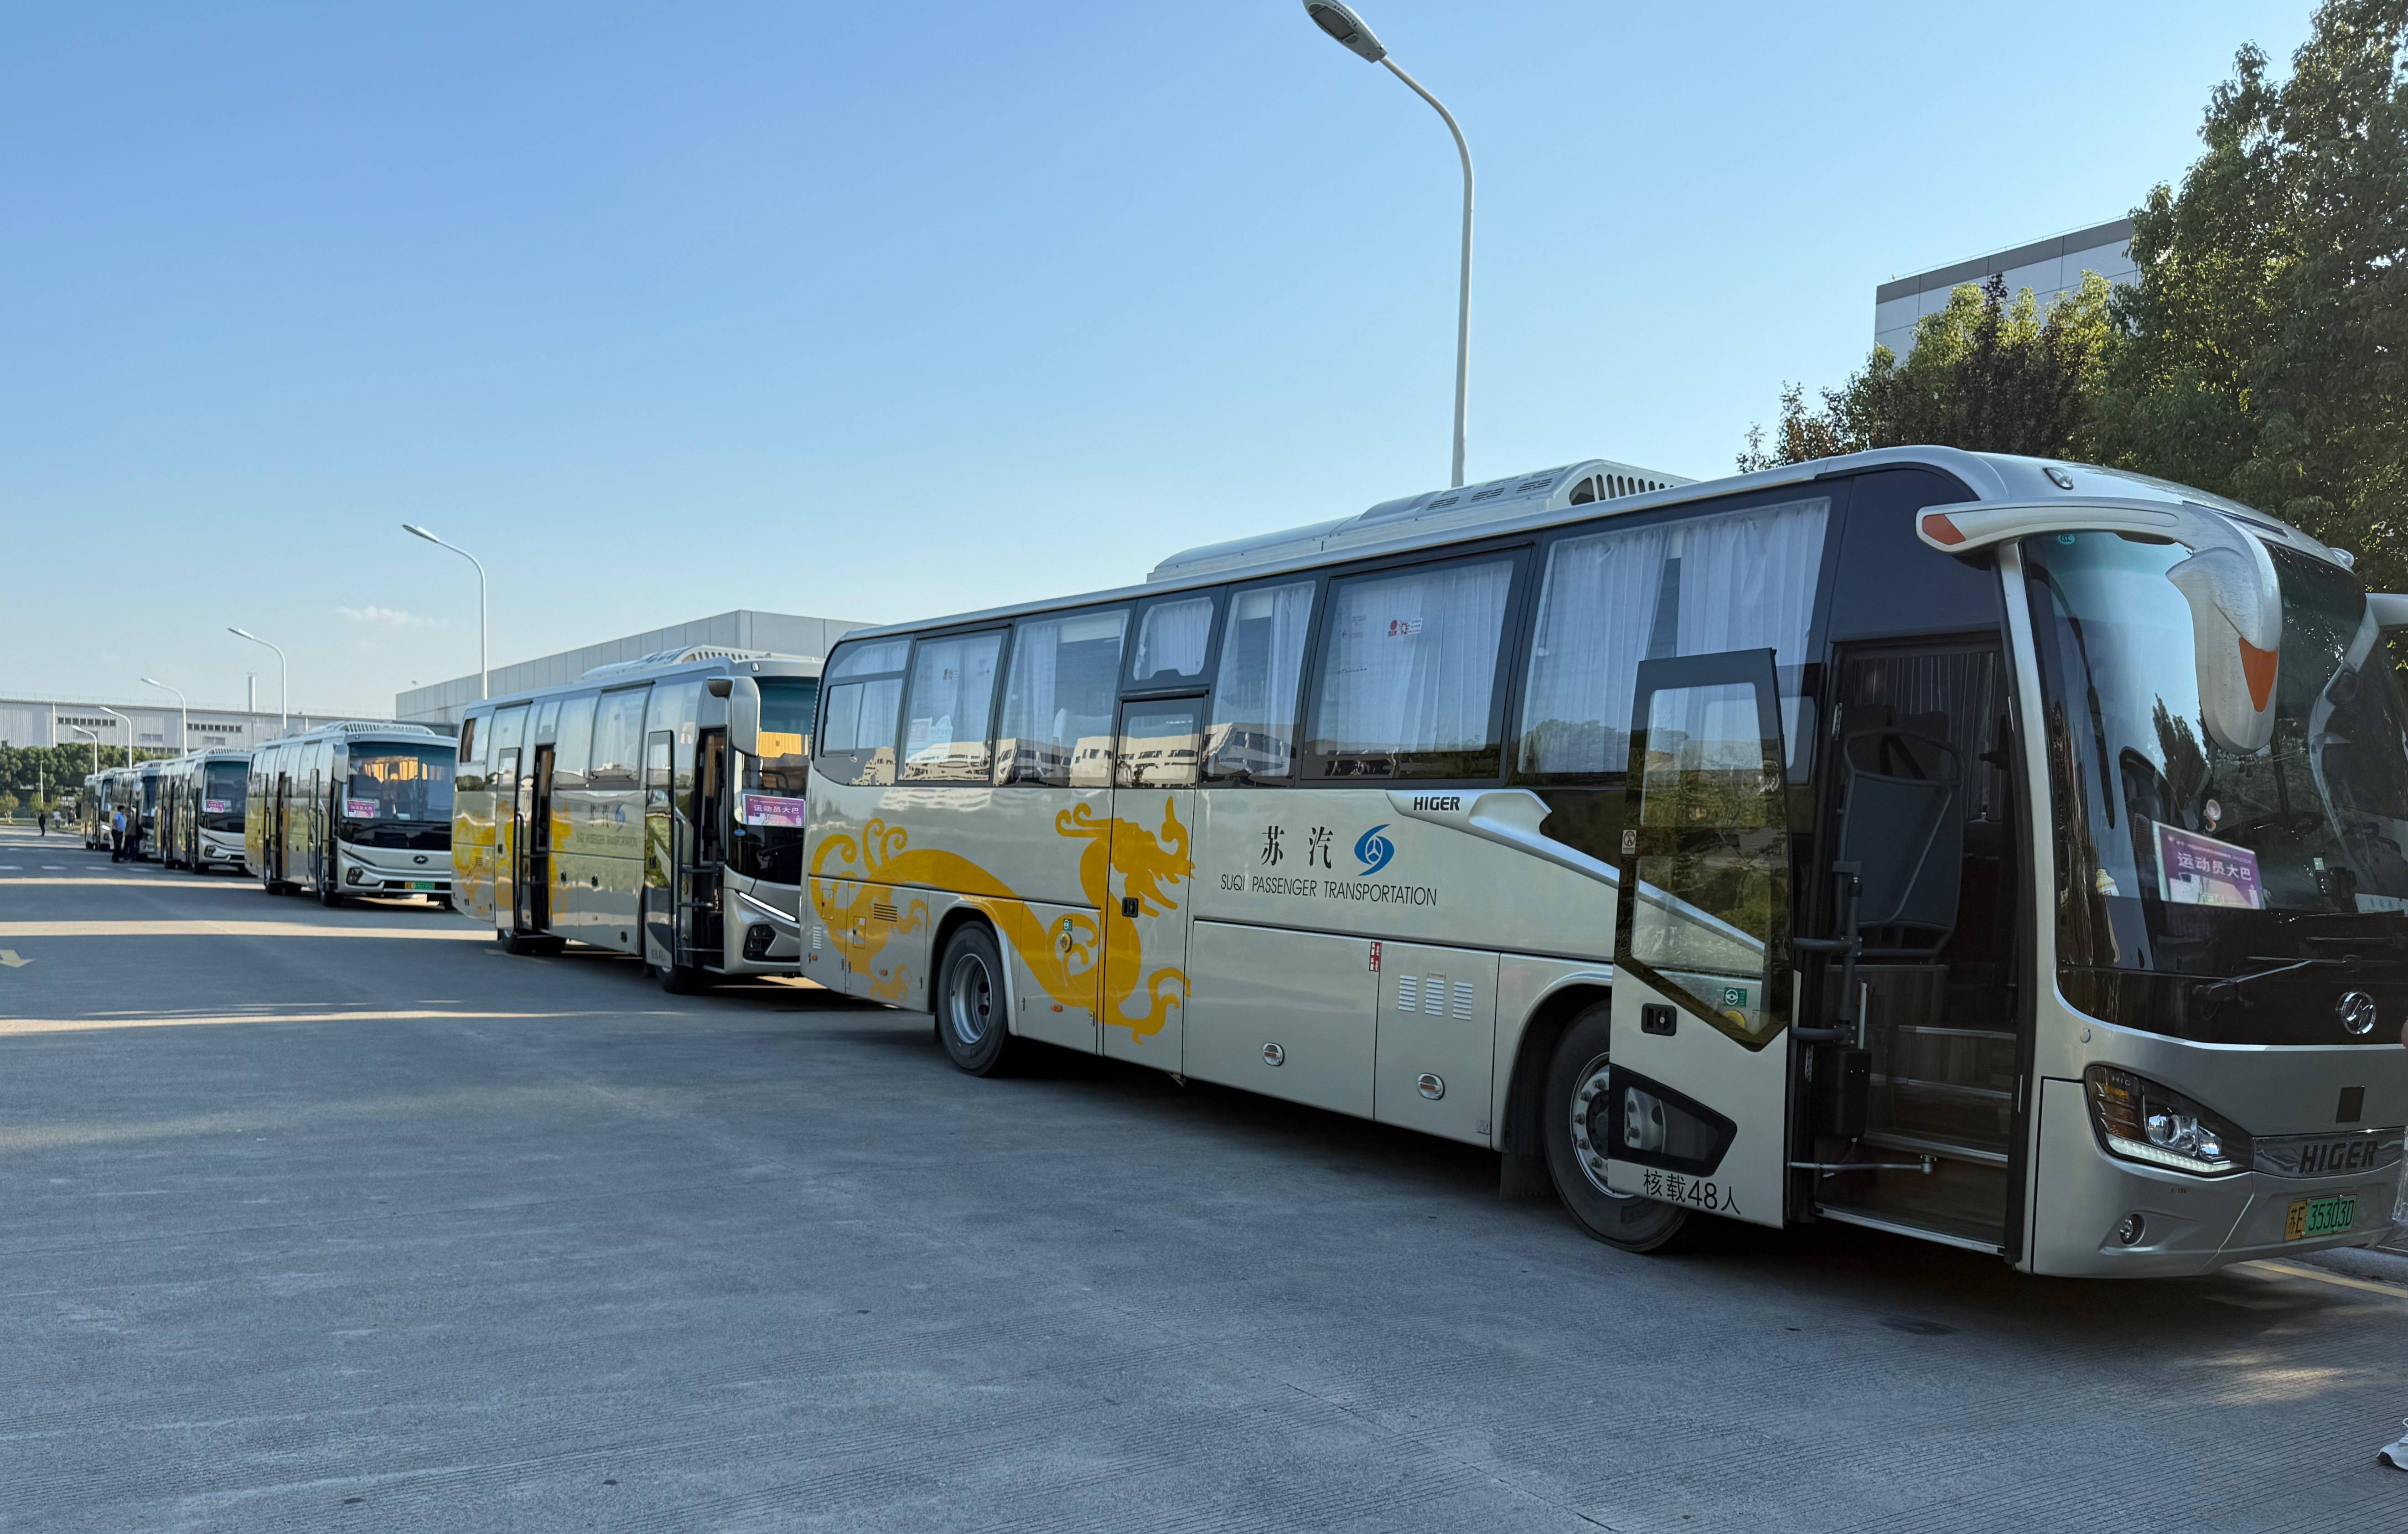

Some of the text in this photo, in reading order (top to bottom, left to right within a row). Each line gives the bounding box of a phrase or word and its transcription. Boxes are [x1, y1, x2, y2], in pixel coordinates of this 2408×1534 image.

[753, 804, 799, 814] 运动员大巴
[1414, 796, 1460, 811] HIGER
[1261, 825, 1333, 869] 苏汽
[2177, 852, 2252, 881] 运动员大巴
[1220, 874, 1437, 906] SUQI PASSENGER TRANSPORTATION
[2299, 1140, 2378, 1173] HIGER
[1643, 1168, 1740, 1215] 核载48人
